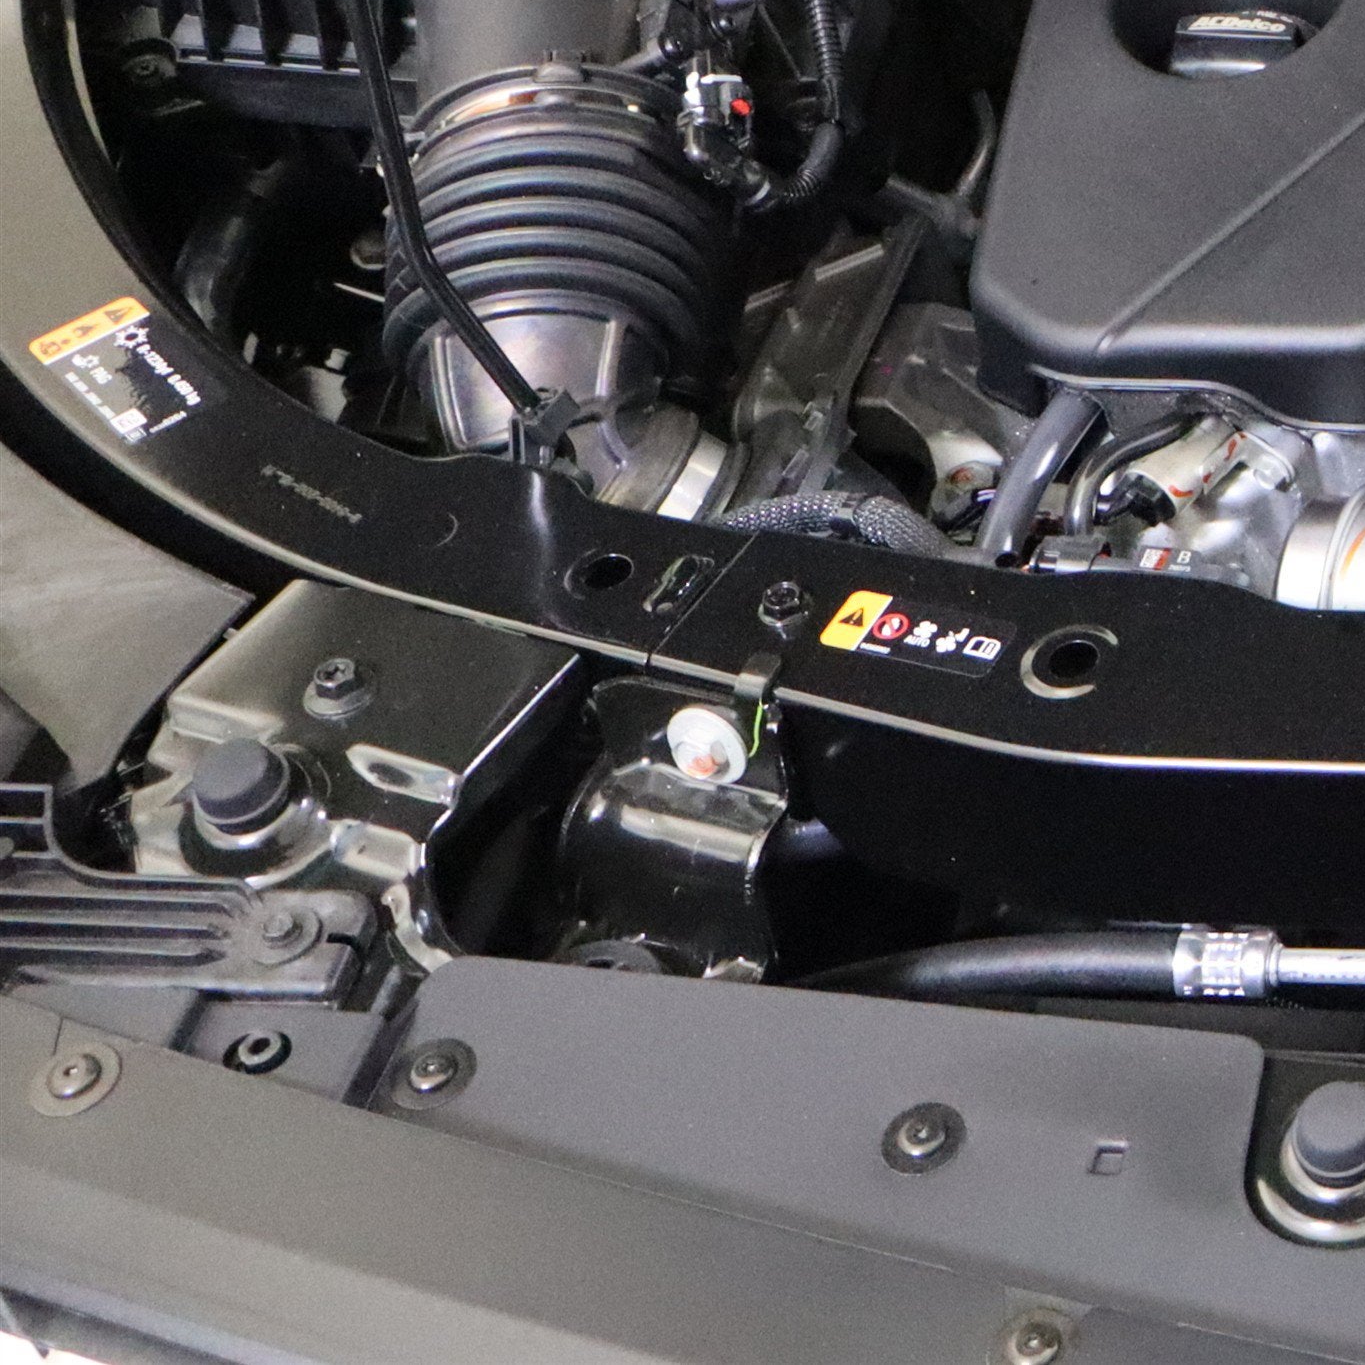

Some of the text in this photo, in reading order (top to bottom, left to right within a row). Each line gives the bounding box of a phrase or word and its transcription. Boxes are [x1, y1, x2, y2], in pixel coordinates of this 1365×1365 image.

[1188, 16, 1286, 32] ACDelco
[90, 366, 113, 385] PAG
[1177, 550, 1191, 563] B
[904, 635, 930, 648] AUTO
